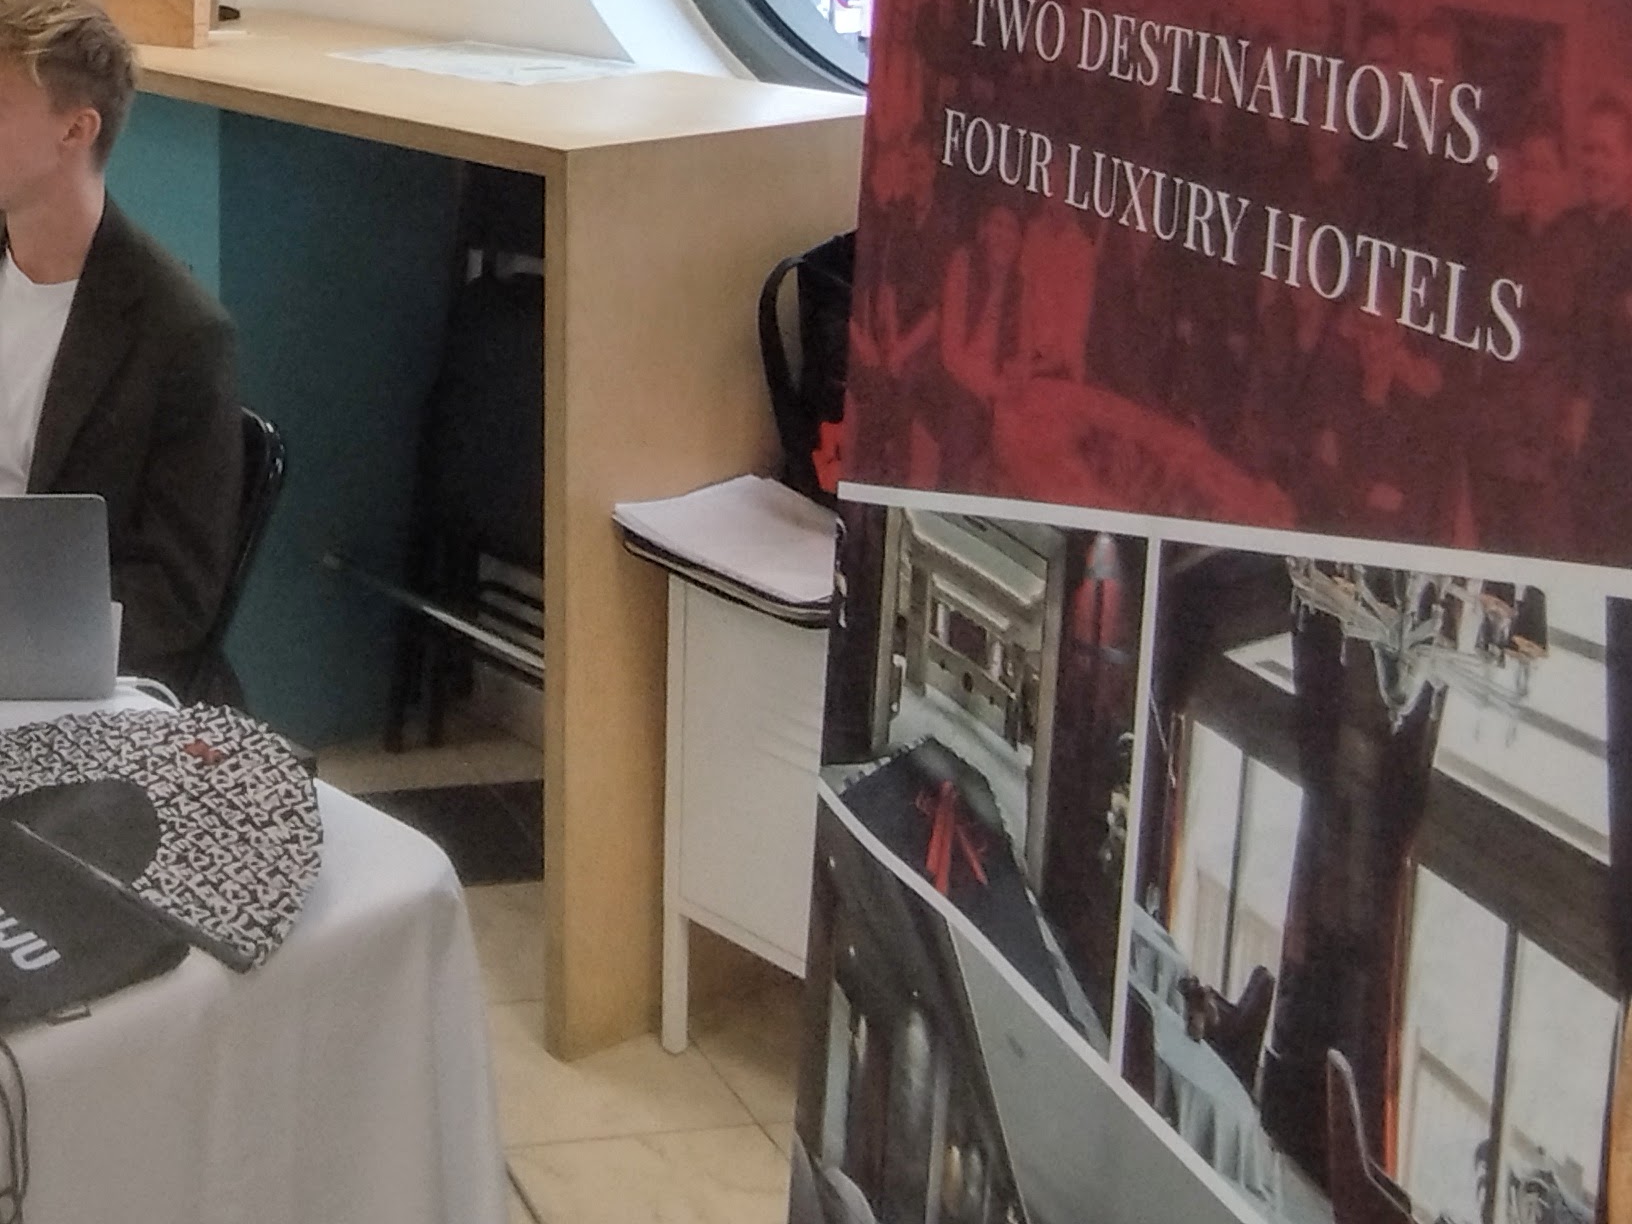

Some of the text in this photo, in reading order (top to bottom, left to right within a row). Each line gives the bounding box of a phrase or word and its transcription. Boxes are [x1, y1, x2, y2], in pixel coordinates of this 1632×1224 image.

[1077, 7, 1500, 185] DESTINATIONS,
[941, 107, 1524, 362] FOUR LUXURY HOTELS
